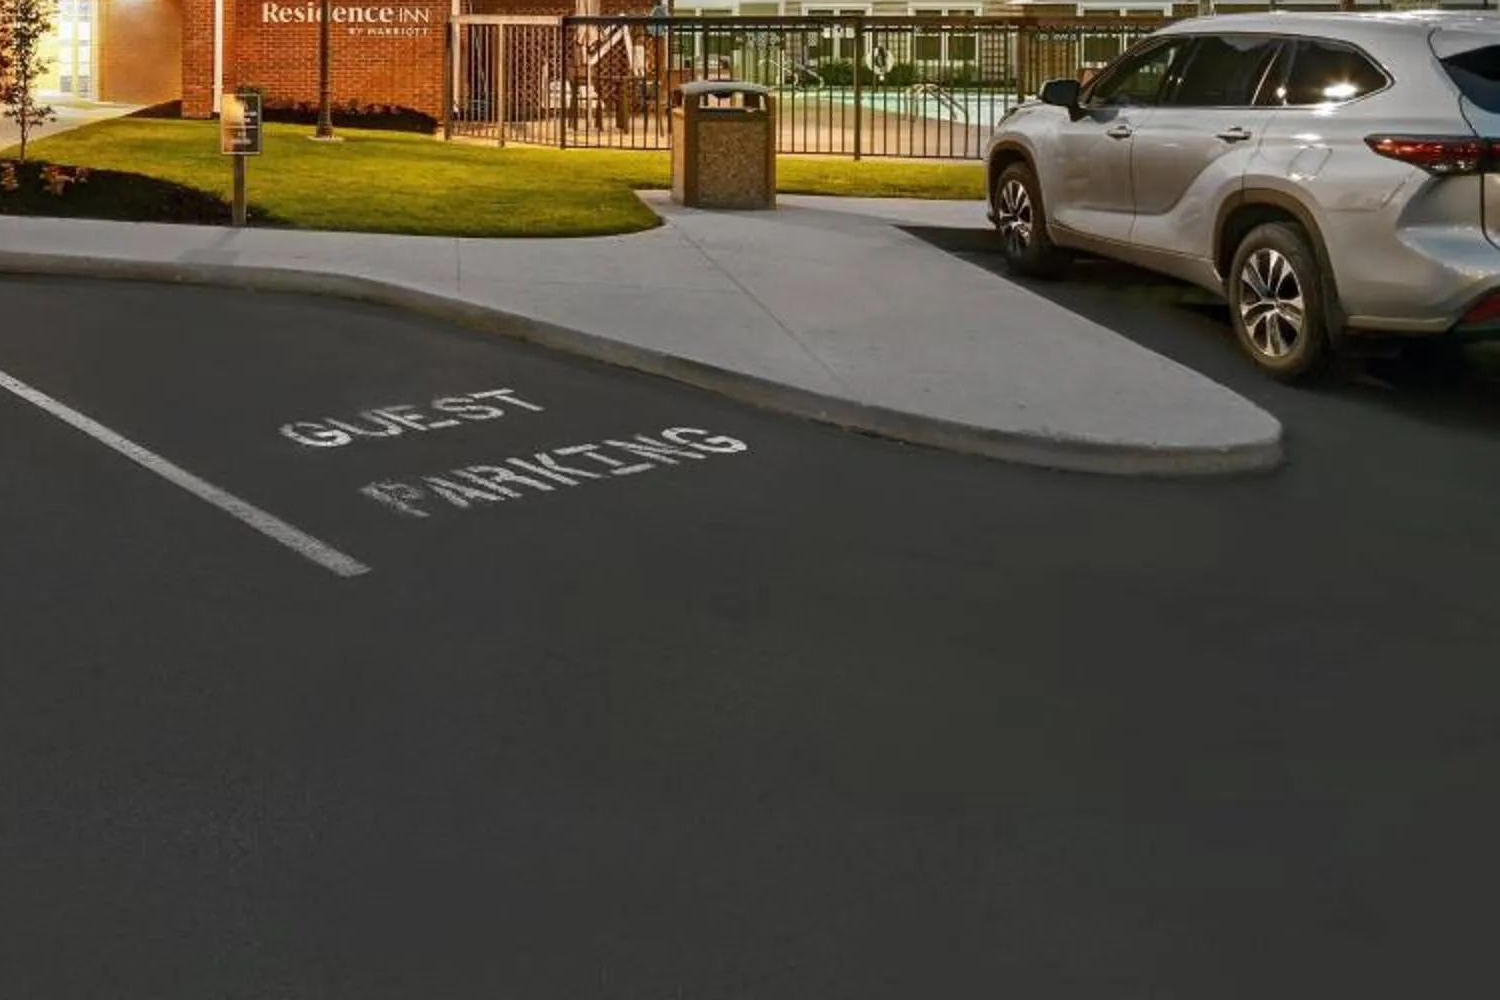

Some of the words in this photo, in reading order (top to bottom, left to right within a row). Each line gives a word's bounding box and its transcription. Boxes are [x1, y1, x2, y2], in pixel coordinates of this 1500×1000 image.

[399, 7, 430, 23] INN
[278, 387, 546, 448] GUEST
[357, 426, 748, 517] PARKING
